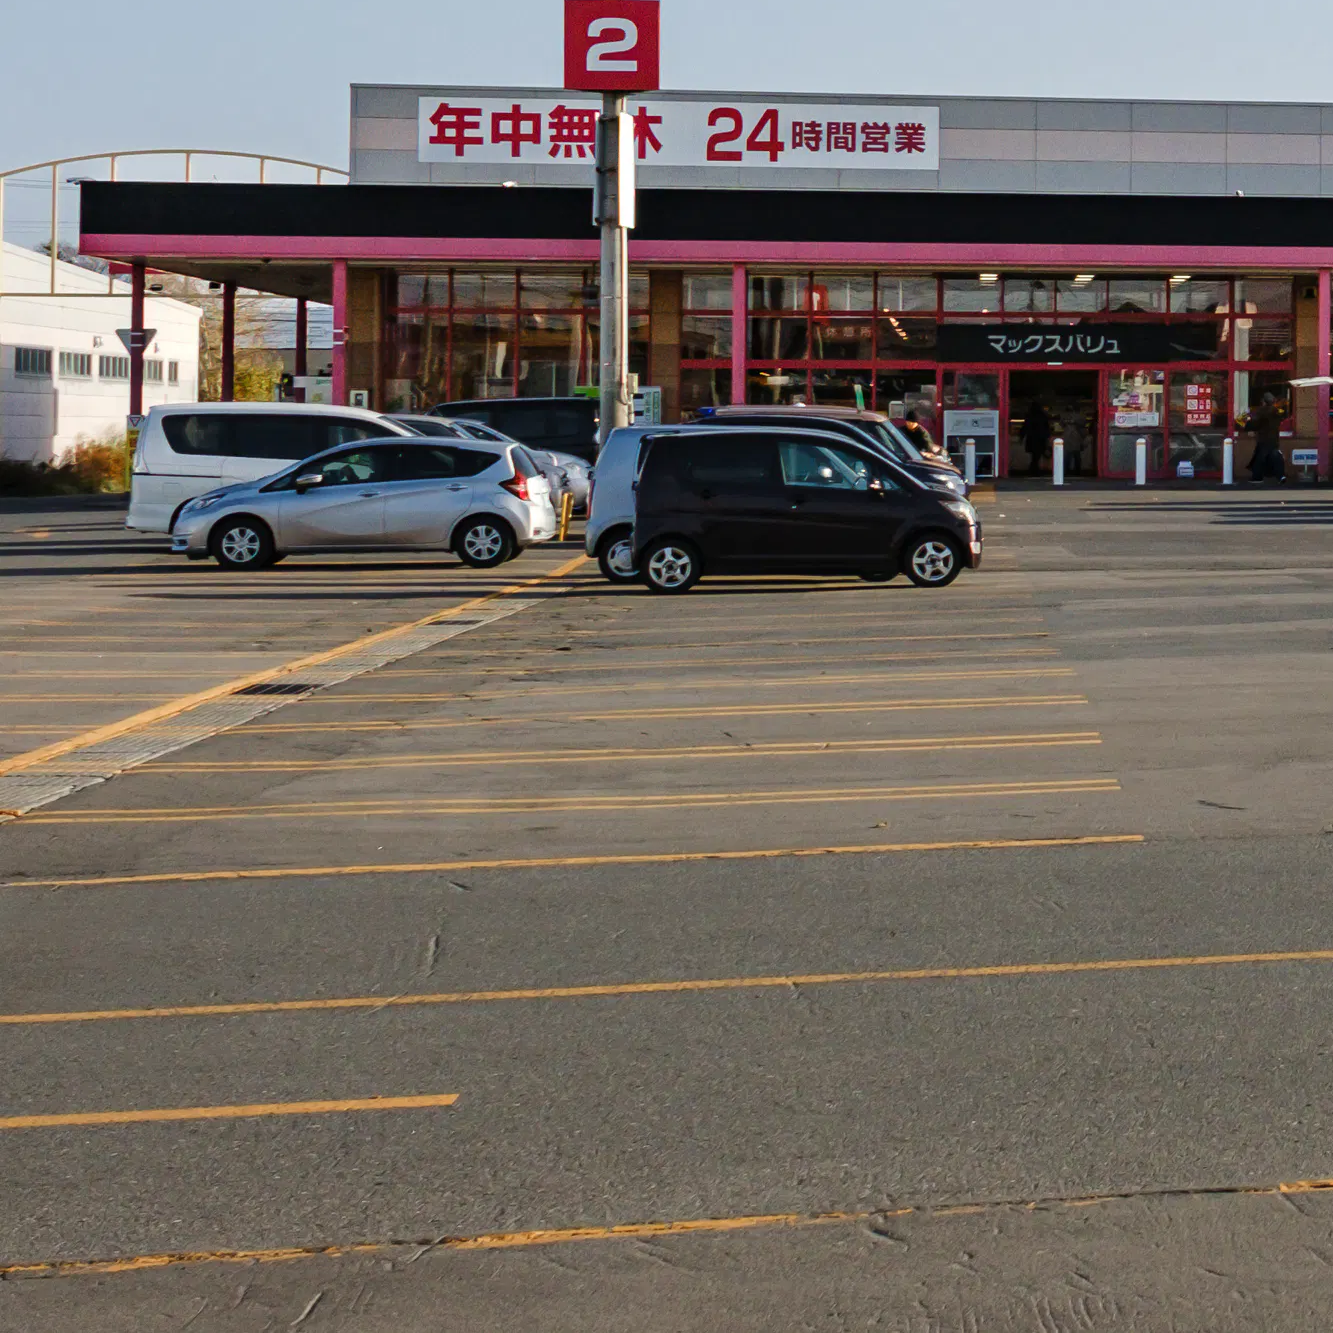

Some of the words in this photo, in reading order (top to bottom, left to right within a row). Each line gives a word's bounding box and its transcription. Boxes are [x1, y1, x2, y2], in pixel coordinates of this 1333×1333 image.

[586, 17, 638, 72] 2
[706, 107, 925, 163] 24時間営業
[987, 334, 1122, 354] マックスバリュ
